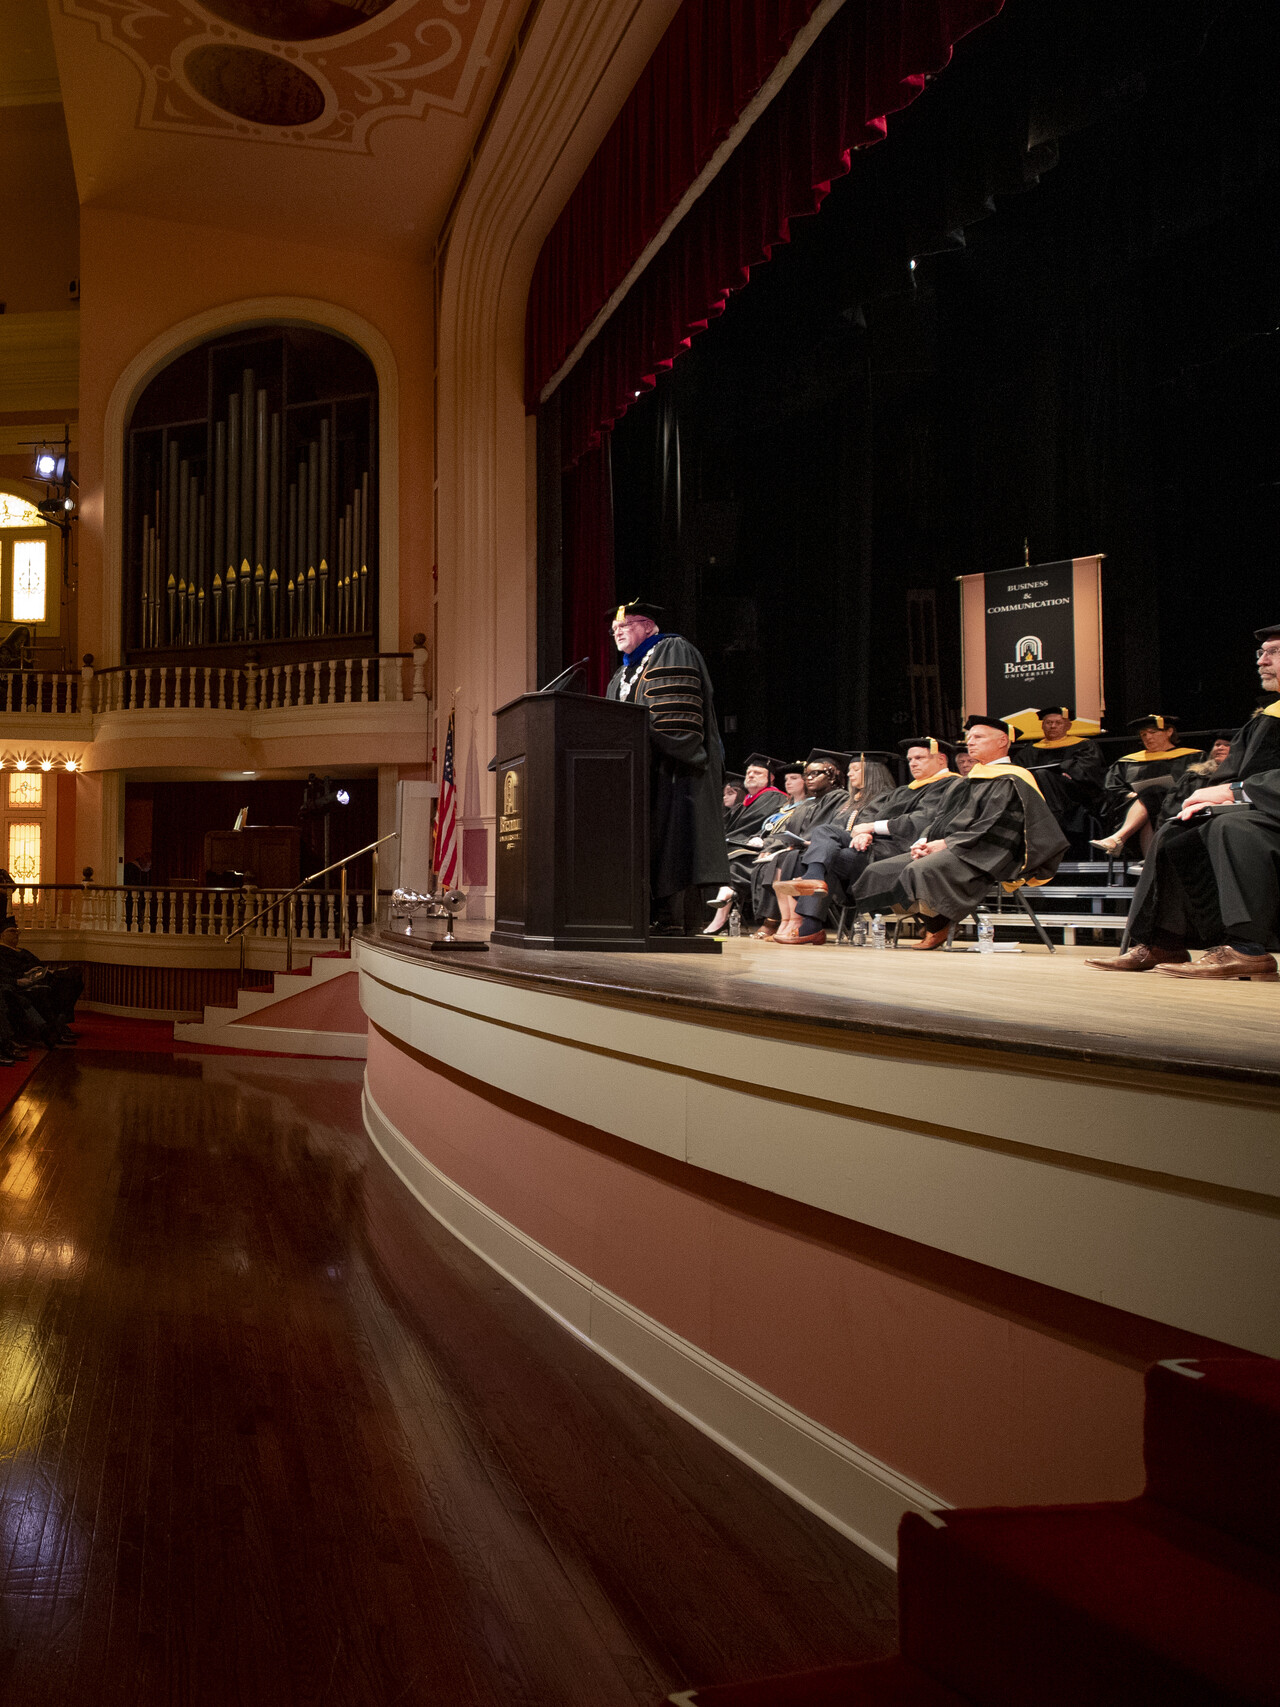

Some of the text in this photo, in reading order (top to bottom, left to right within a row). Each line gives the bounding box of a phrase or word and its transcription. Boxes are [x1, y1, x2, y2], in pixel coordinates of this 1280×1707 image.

[1007, 580, 1049, 592] BUSINESS
[987, 597, 1070, 614] COMMUNICATION
[1004, 661, 1055, 674] Brenau
[1004, 670, 1055, 679] UNIVERSITY
